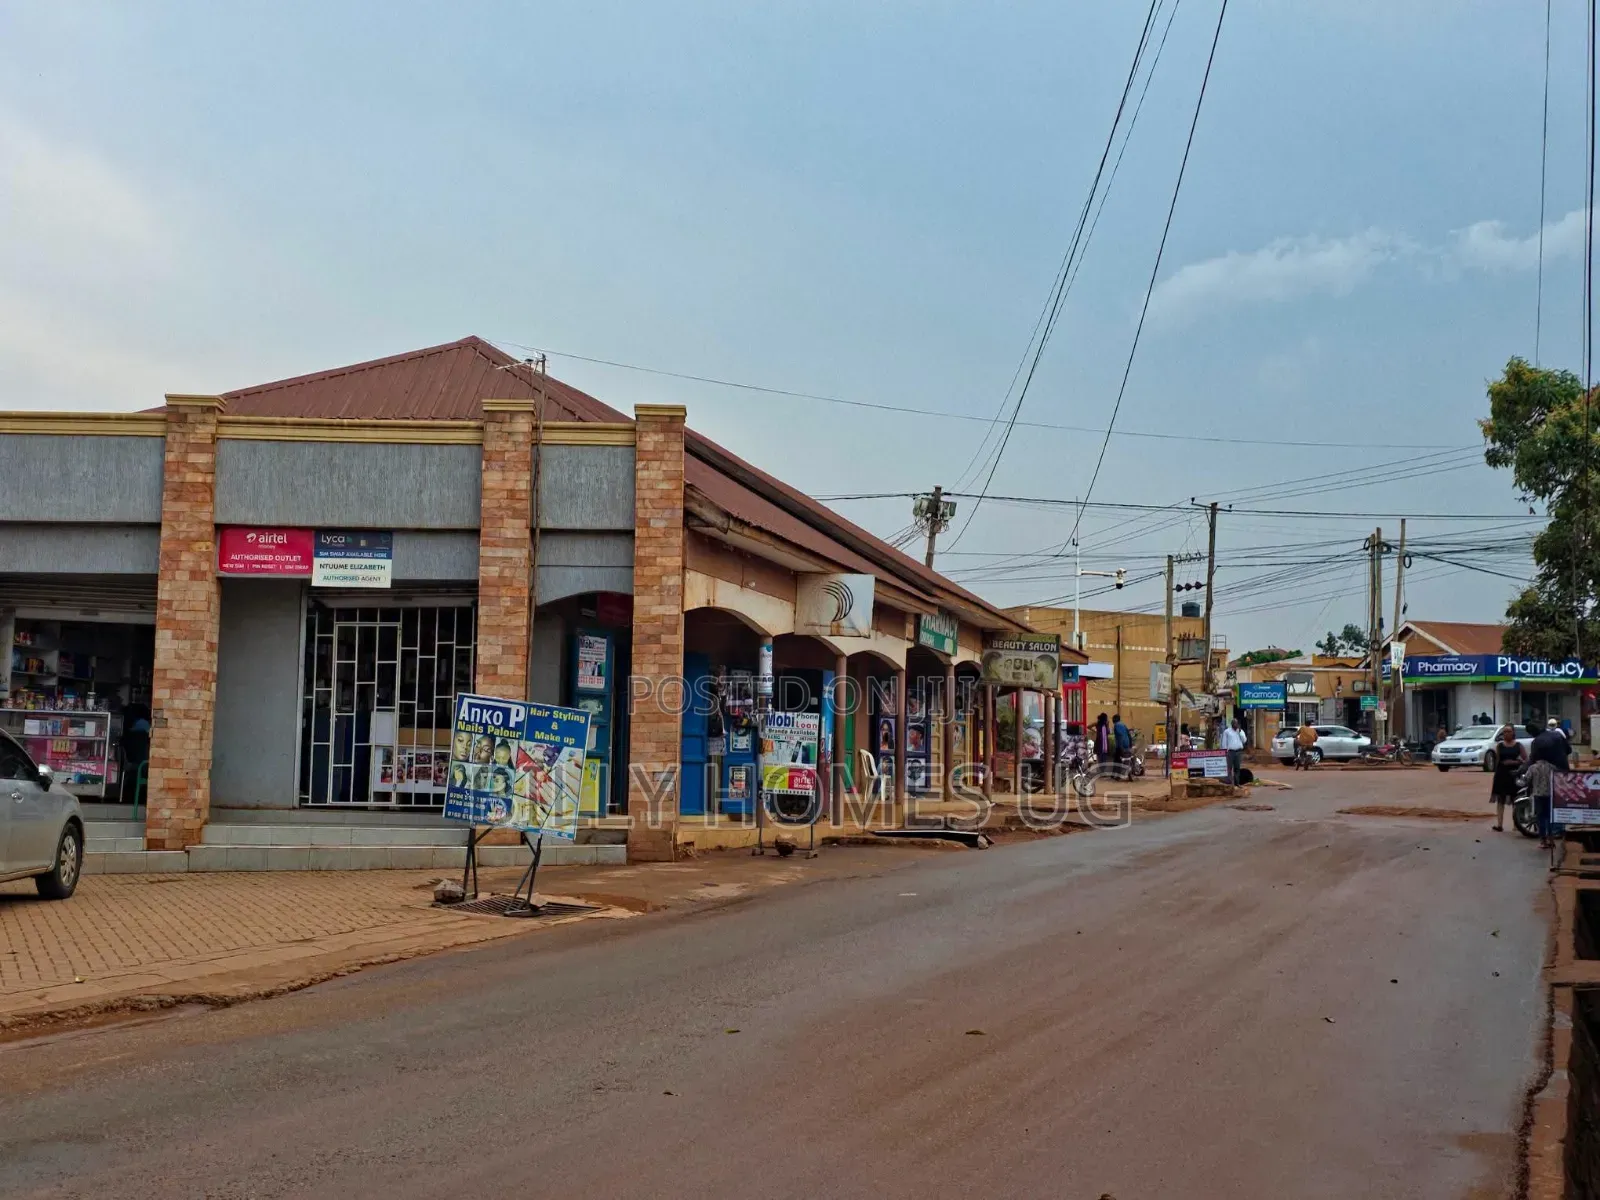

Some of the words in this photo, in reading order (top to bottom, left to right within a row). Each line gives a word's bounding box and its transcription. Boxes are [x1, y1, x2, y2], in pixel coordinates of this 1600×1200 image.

[259, 532, 287, 544] airtel
[321, 534, 345, 544] Lyca
[921, 613, 959, 640] PHARMACY
[992, 640, 1027, 650] BEAUTY
[1028, 642, 1057, 652] SALON
[1418, 661, 1478, 673] Pharmacy
[1497, 656, 1585, 678] Pharmacy
[1244, 690, 1282, 699] Pharmacy
[509, 703, 525, 728] P
[530, 707, 550, 717] Hair
[553, 710, 586, 723] Styling
[765, 713, 795, 728] Mobi
[457, 721, 484, 734] Nails
[487, 724, 522, 739] Palour
[551, 722, 558, 731] &
[796, 721, 818, 729] Loan
[534, 731, 561, 742] Make
[563, 736, 576, 745] up
[793, 776, 814, 784] airtel
[793, 783, 813, 791] Money
